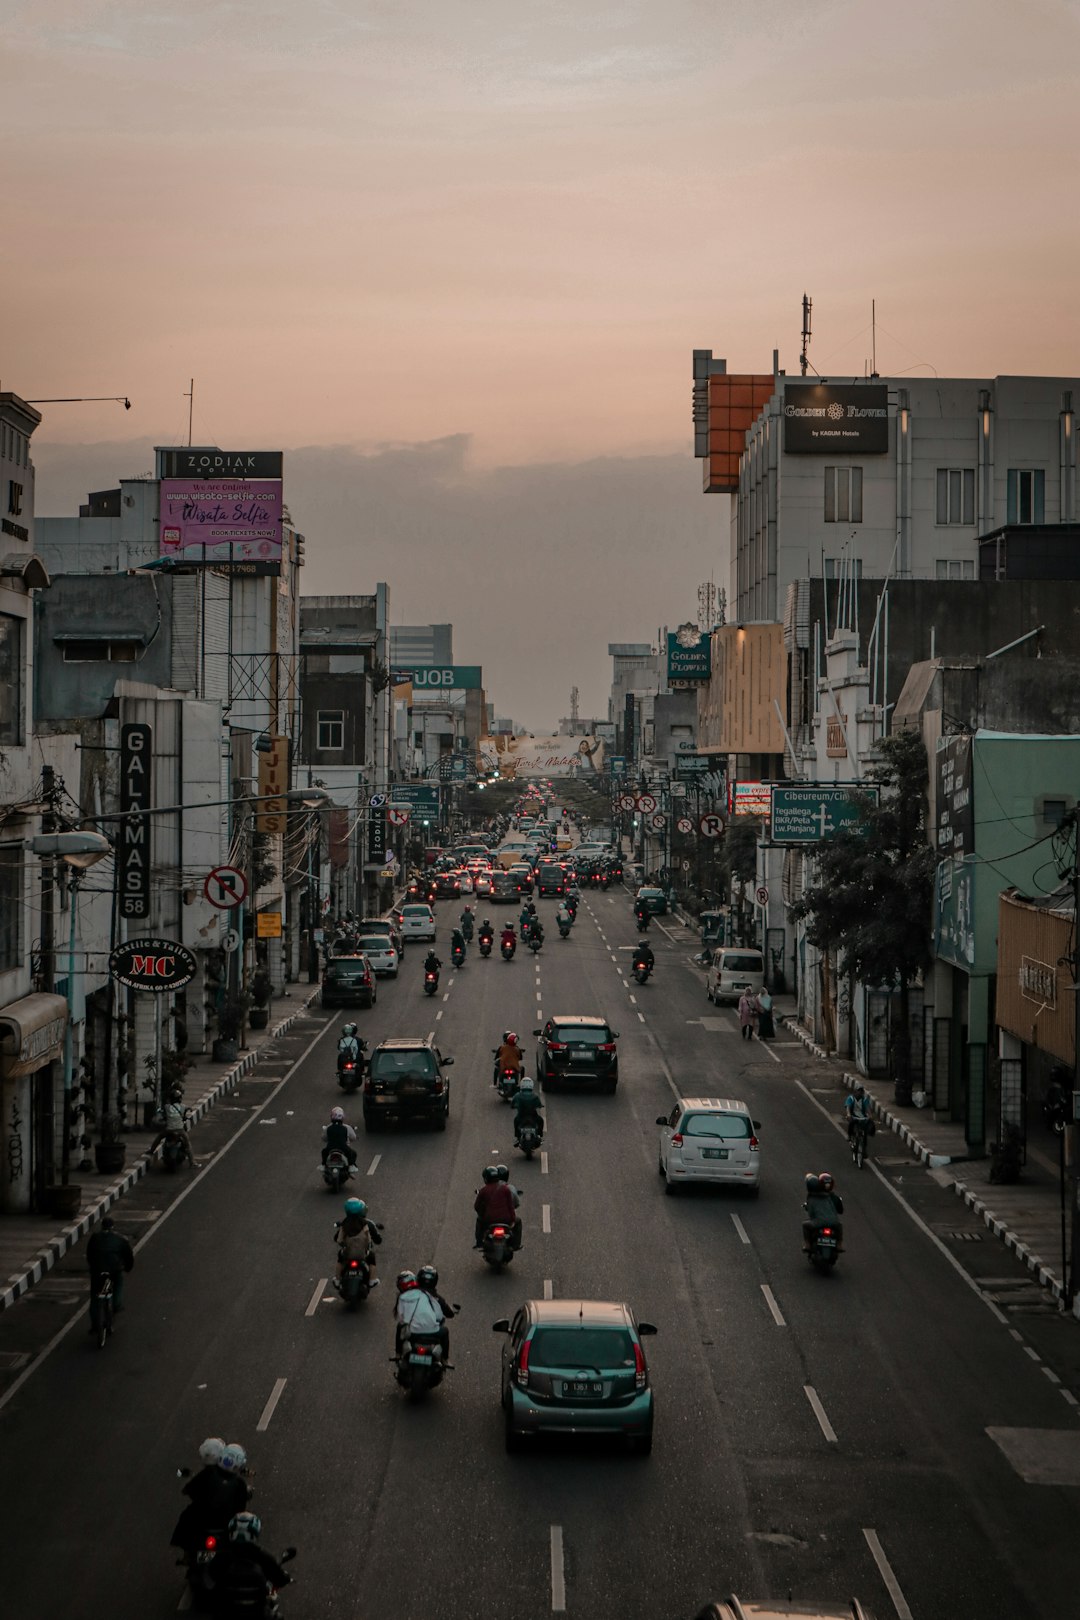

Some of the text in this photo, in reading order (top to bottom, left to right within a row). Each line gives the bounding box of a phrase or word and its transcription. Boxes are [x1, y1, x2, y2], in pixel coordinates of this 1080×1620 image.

[188, 456, 256, 467] ZODIAK
[166, 492, 276, 500] www.wisata-selfie.com
[182, 502, 270, 525] Wisata Selfie
[415, 670, 454, 685] UOB
[125, 732, 144, 890] GALAMAS
[776, 808, 811, 816] Tegallega
[775, 816, 810, 824] BKR/Peta
[775, 825, 815, 834] Lw.Panjang
[125, 901, 144, 913] 58
[112, 941, 150, 958] Textile
[162, 942, 192, 963] Tailor
[129, 954, 175, 978] MC
[119, 976, 132, 986] ASIA
[132, 982, 154, 990] AFRIKA
